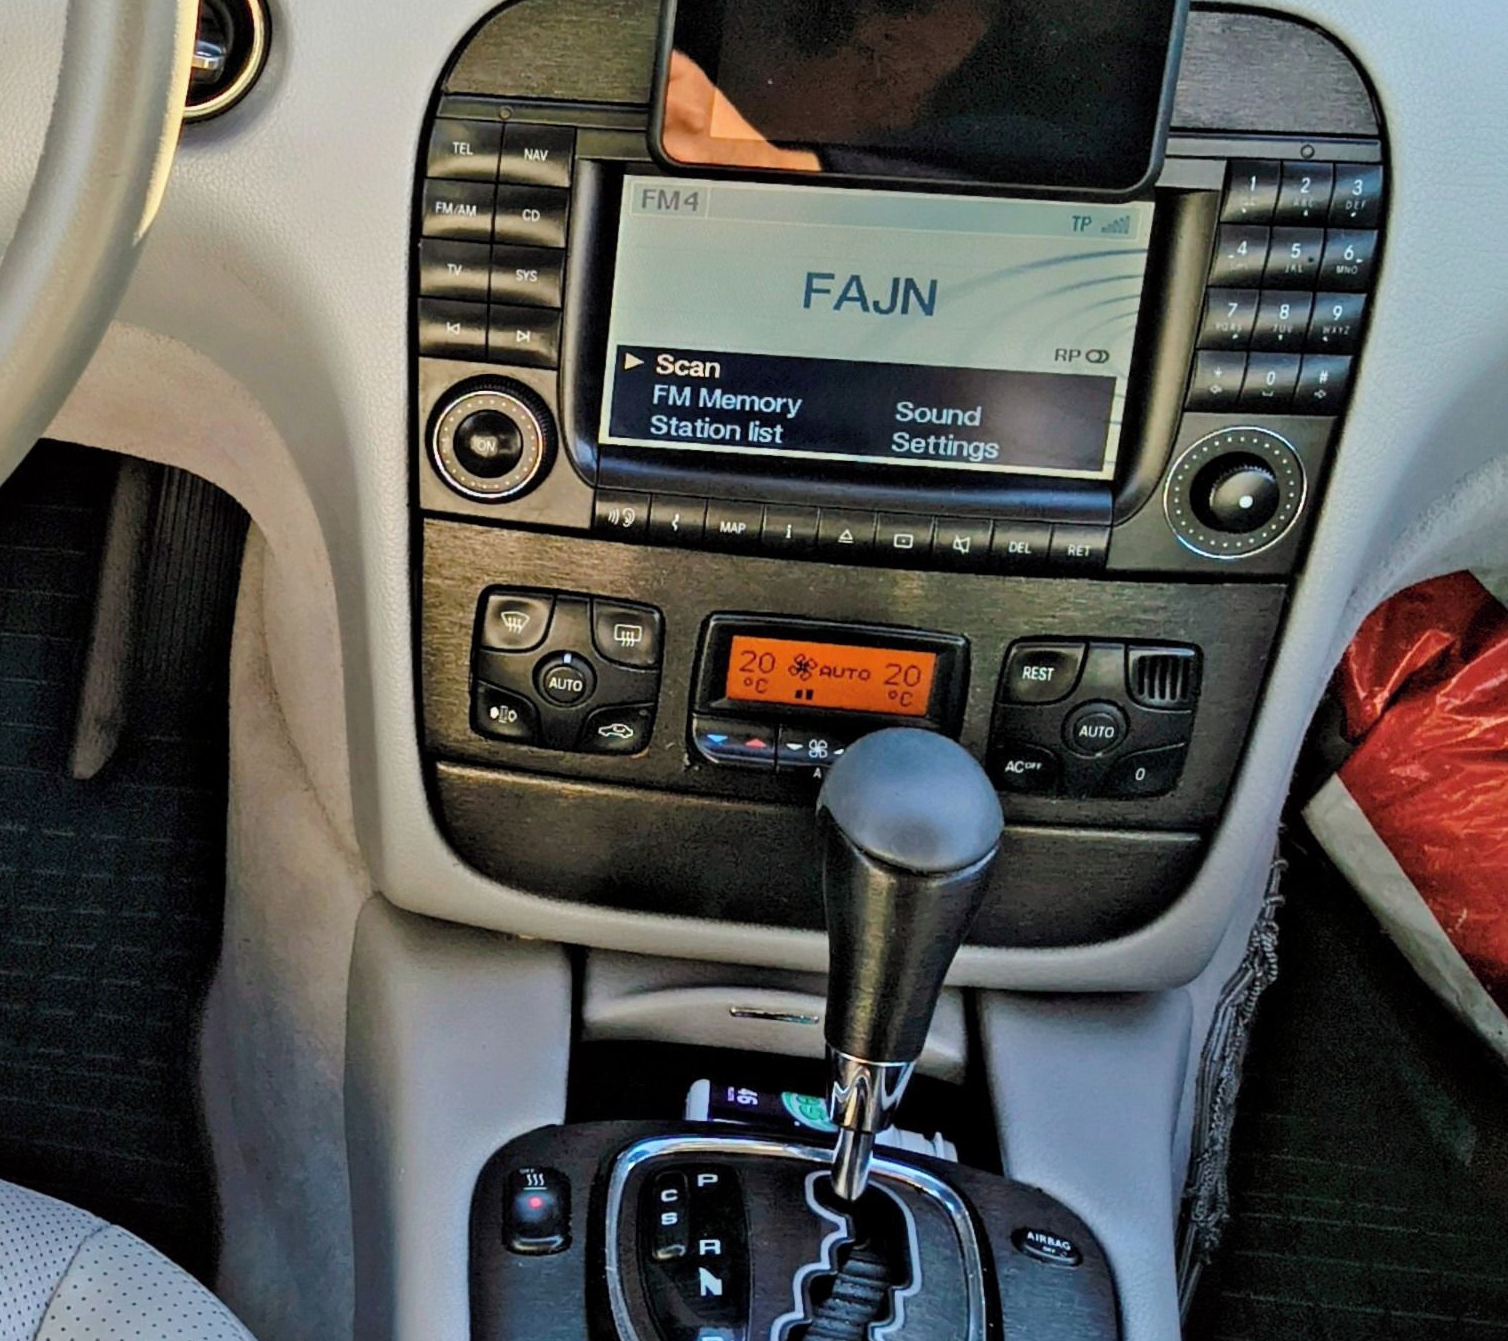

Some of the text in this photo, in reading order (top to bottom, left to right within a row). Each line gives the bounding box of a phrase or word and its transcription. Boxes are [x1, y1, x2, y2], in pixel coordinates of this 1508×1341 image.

[452, 141, 474, 157] TEL
[523, 148, 549, 162] NAV
[1249, 175, 1257, 191] 1
[1300, 177, 1311, 194] 2
[1352, 179, 1363, 196] 3
[435, 201, 477, 217] FM/AM
[522, 209, 541, 223] CD
[1071, 215, 1092, 233] TP
[1237, 240, 1248, 255] 4
[1290, 243, 1301, 259] 5
[1344, 245, 1355, 261] 6
[447, 263, 463, 277] TV
[516, 269, 538, 283] SYS
[802, 271, 938, 317] FAJN
[1227, 302, 1238, 318] 7
[1279, 305, 1290, 320] 8
[1333, 305, 1343, 321] 9
[1054, 348, 1082, 363] RP
[655, 353, 721, 379] Scan
[652, 384, 803, 418] FM Memory
[895, 400, 982, 427] Sound
[650, 414, 784, 443] Station list
[476, 439, 496, 453] ON
[891, 431, 1000, 461] Settings
[720, 520, 746, 535] MAP
[1008, 540, 1032, 555] DEL
[1067, 542, 1091, 557] RET
[739, 650, 776, 674] 20
[819, 666, 871, 681] AUTO
[884, 663, 921, 688] 20
[1022, 665, 1055, 682] REST
[548, 678, 583, 693] AUTO
[1078, 725, 1116, 739] AUTO
[697, 1174, 718, 1187] P
[660, 1189, 679, 1202] C
[660, 1212, 678, 1226] S
[699, 1239, 721, 1256] R
[1027, 1231, 1072, 1251] AIRBAG
[698, 1266, 723, 1297] N
